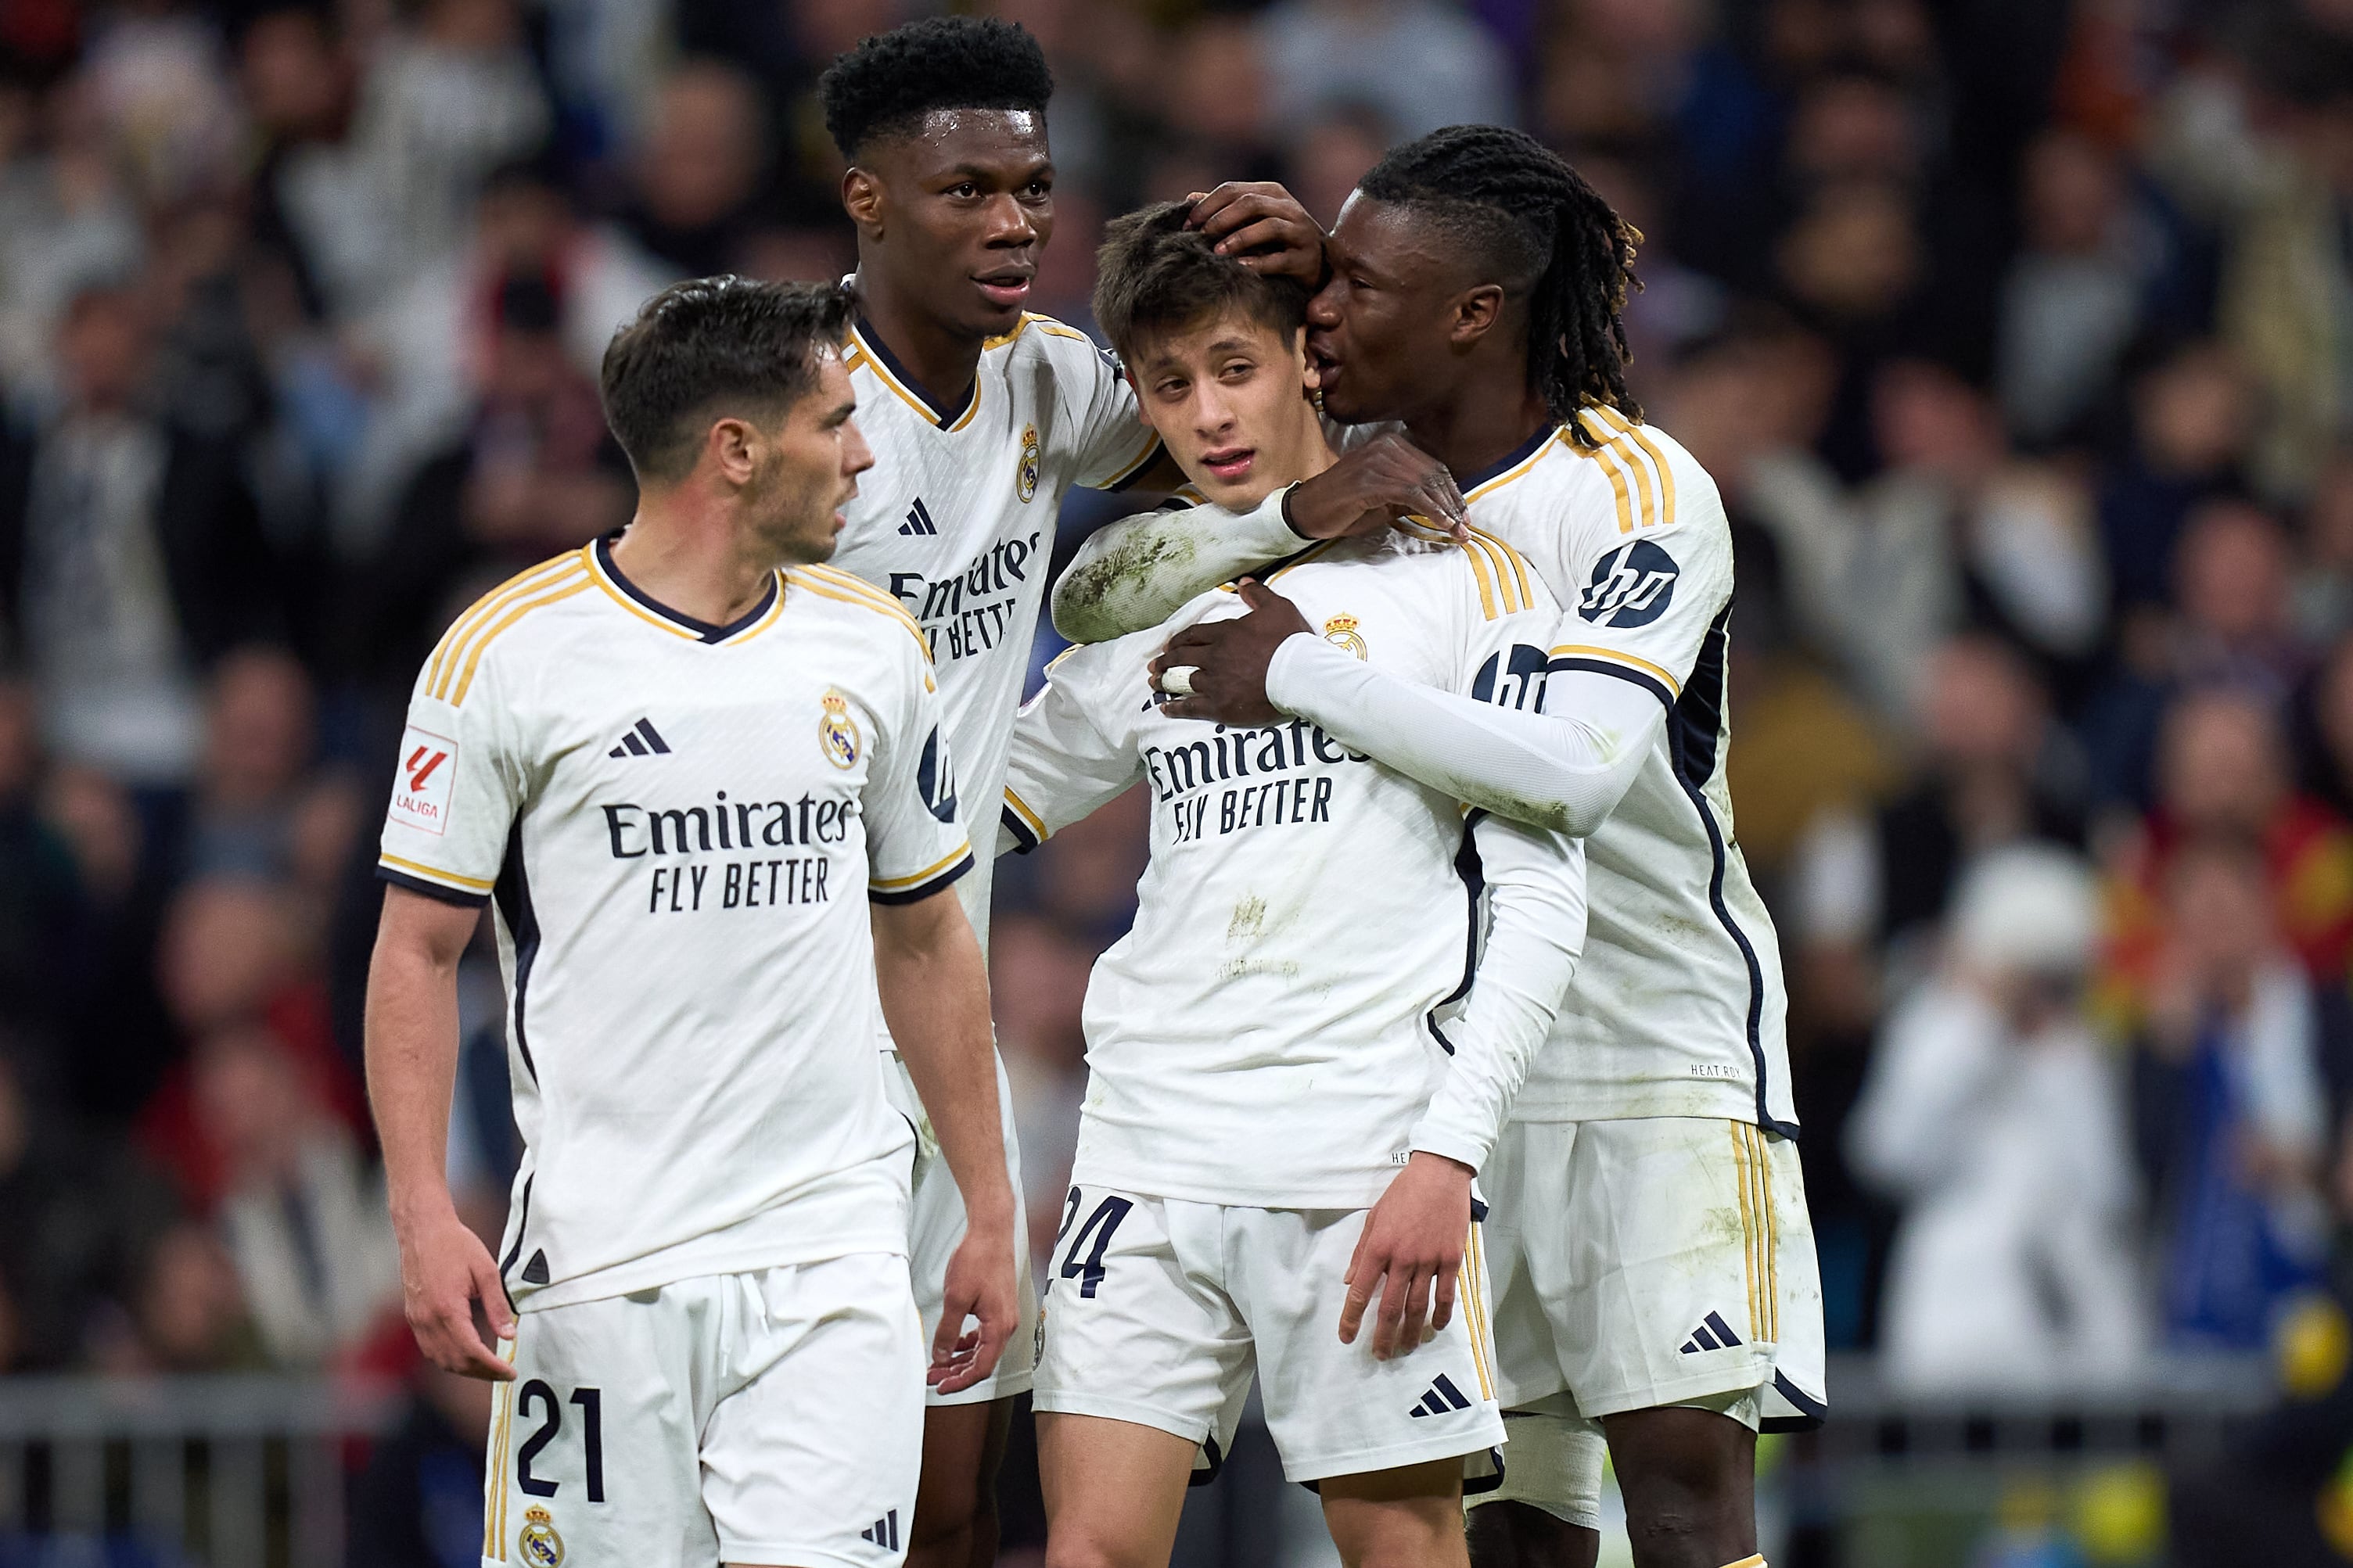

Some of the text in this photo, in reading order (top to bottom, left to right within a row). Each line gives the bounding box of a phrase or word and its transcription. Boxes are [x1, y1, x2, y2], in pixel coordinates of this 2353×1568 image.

[1580, 540, 1679, 627] hp
[396, 794, 438, 819] LALIGA
[599, 790, 854, 859] Emirates
[1173, 777, 1333, 845] FLY BETTER
[650, 857, 829, 913] FLY BETTER
[517, 1378, 605, 1503] 21
